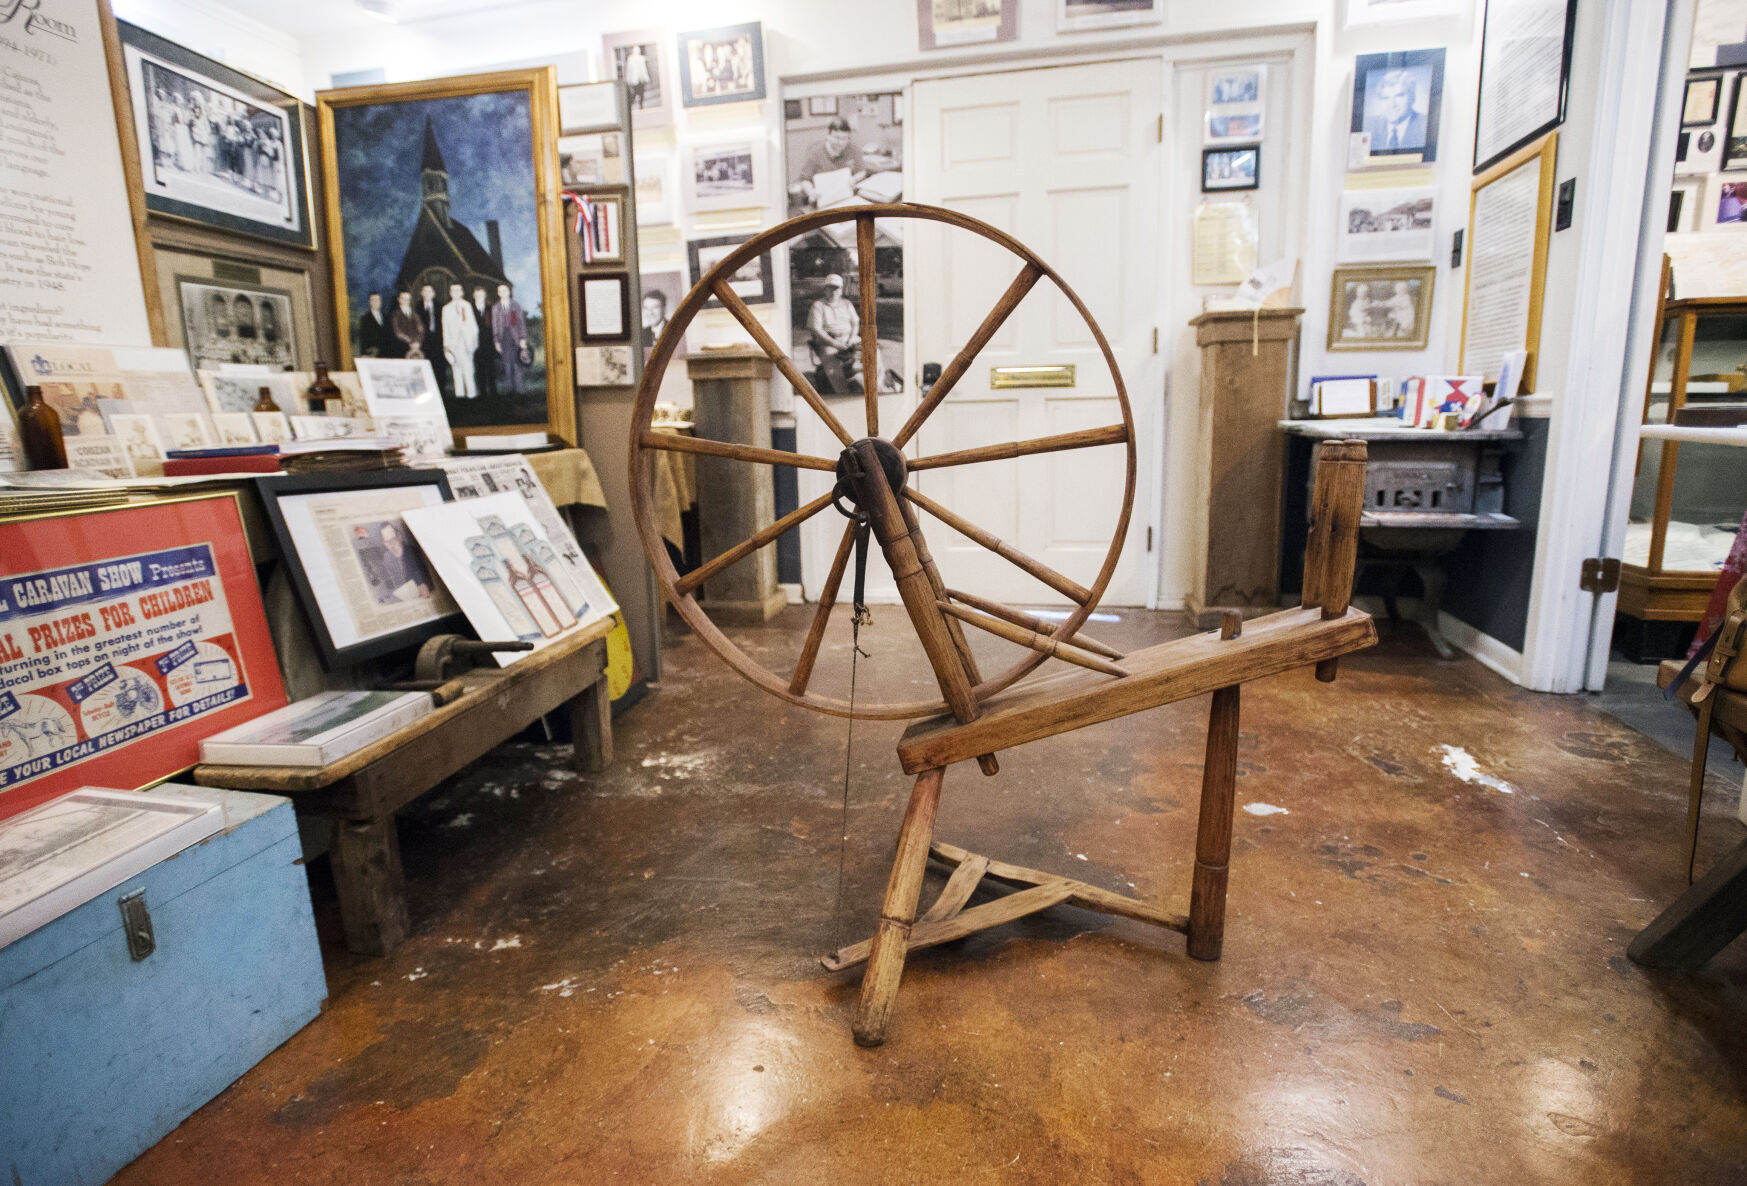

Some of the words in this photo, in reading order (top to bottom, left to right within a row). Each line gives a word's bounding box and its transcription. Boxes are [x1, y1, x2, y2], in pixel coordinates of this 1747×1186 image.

[13, 571, 94, 608] CARAVAN
[97, 560, 143, 591] SHOW
[149, 558, 206, 581] Presents
[27, 612, 96, 653] PRIZES
[99, 602, 135, 632] FOR
[139, 579, 214, 620] CHILDREN
[54, 650, 67, 660] in
[71, 645, 90, 656] the
[95, 631, 142, 651] greatest
[146, 619, 186, 635] number
[190, 614, 200, 624] of
[36, 666, 63, 679] box
[66, 657, 91, 670] tops
[94, 653, 109, 663] on
[112, 643, 140, 657] night
[143, 638, 154, 649] of
[157, 634, 173, 645] the
[13, 757, 51, 779] YOUR
[56, 742, 96, 764] LOCAL
[99, 715, 166, 748] NEWSPAPER
[168, 706, 191, 721] FOR
[192, 689, 235, 713] DETAILS!
